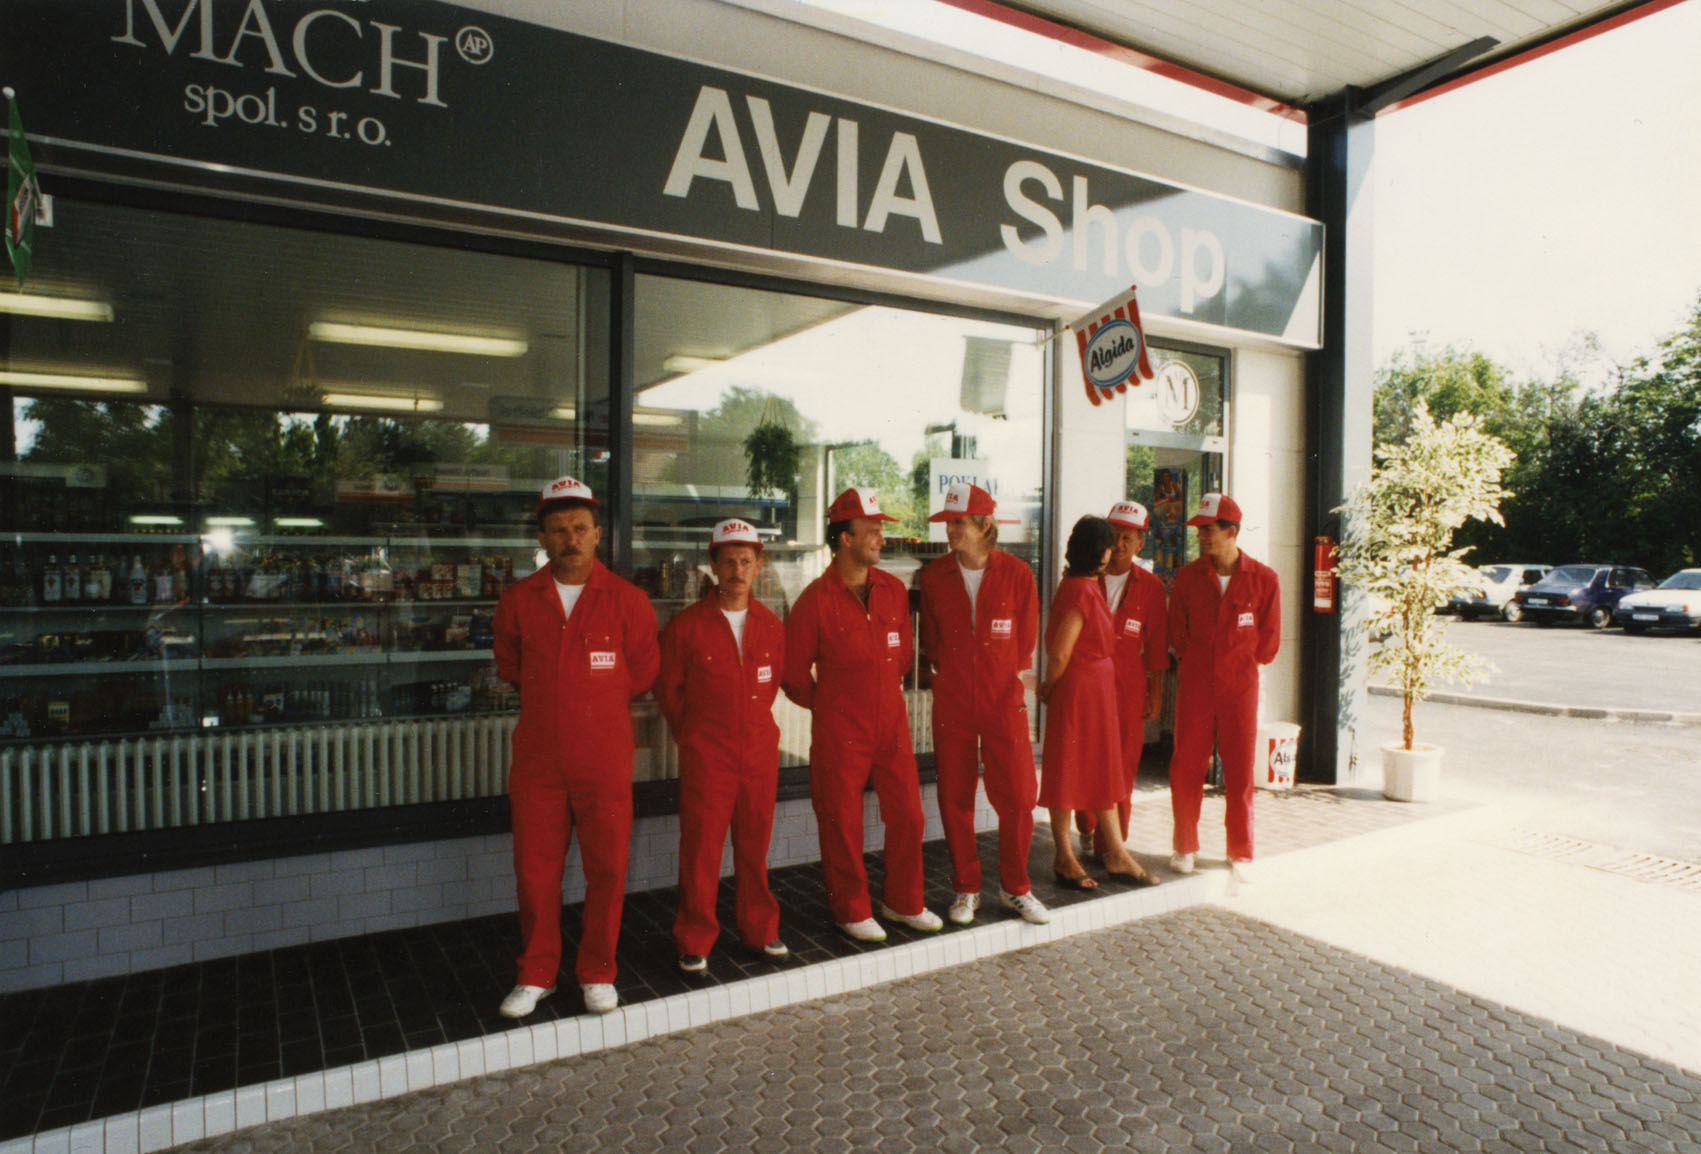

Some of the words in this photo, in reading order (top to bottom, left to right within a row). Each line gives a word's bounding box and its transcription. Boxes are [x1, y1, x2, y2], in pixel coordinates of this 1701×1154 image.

[111, 0, 448, 108] MACH
[184, 83, 288, 127] spol.
[298, 105, 317, 133] s
[328, 110, 392, 146] r.o.
[663, 85, 943, 245] AVIA
[1000, 160, 1226, 313] Shop
[1090, 336, 1135, 374] Algida
[552, 480, 581, 491] AVIA
[1118, 504, 1138, 514] AVIA
[722, 523, 749, 532] AVIA
[592, 655, 614, 663] AVIA
